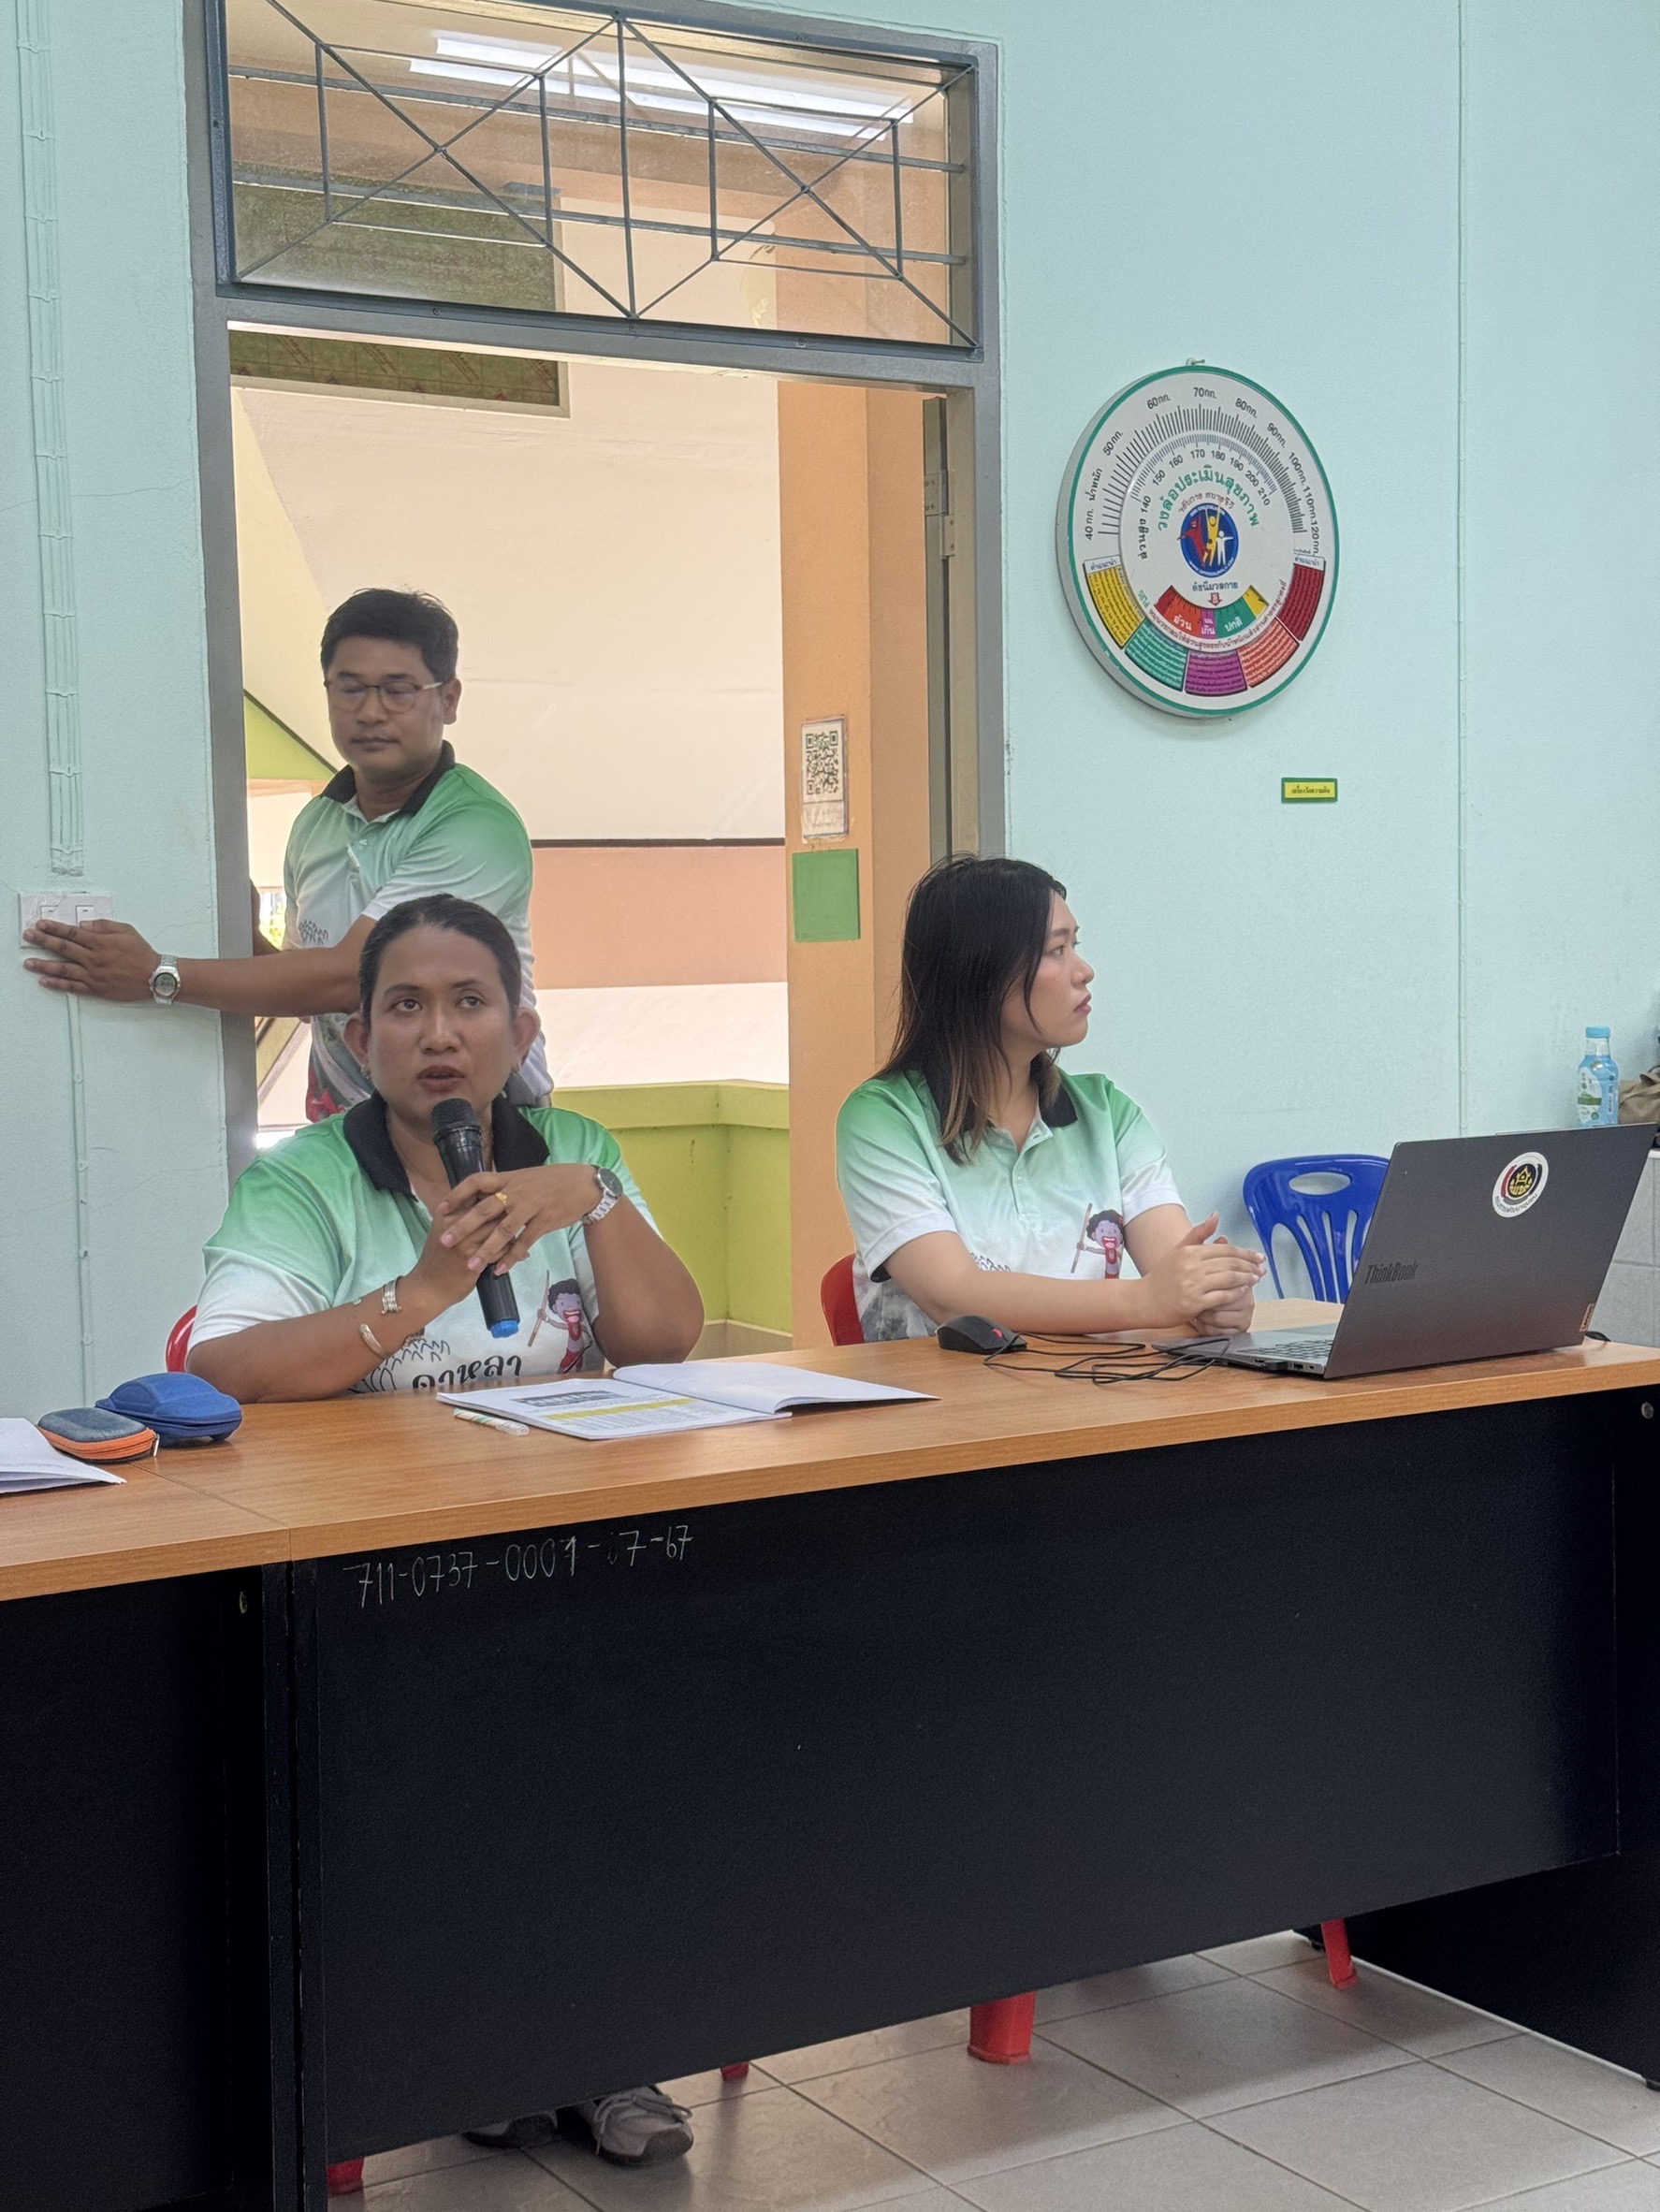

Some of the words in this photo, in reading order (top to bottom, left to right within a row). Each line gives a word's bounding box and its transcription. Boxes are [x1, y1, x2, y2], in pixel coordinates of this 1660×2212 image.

[1193, 386, 1217, 399] 70กก.
[1146, 393, 1172, 410] 60กก.
[1235, 398, 1259, 418] 80กก.
[1102, 430, 1124, 457] 50กก.
[1266, 422, 1287, 448] 90กก.
[1169, 454, 1184, 469] 160
[1190, 448, 1205, 459] 170
[1211, 450, 1226, 461] 180
[1230, 457, 1245, 472] 190
[1152, 469, 1167, 487] 150
[1245, 470, 1260, 488] 200
[1140, 495, 1152, 514] 140
[1158, 464, 1260, 531] วงล้อประเมินสุขภาพ
[1258, 488, 1271, 506] 210
[1172, 614, 1192, 631] อ้วน
[1201, 624, 1216, 635] เกิน
[1224, 616, 1243, 633] ปกติ
[1364, 1260, 1419, 1284] ThinkBook
